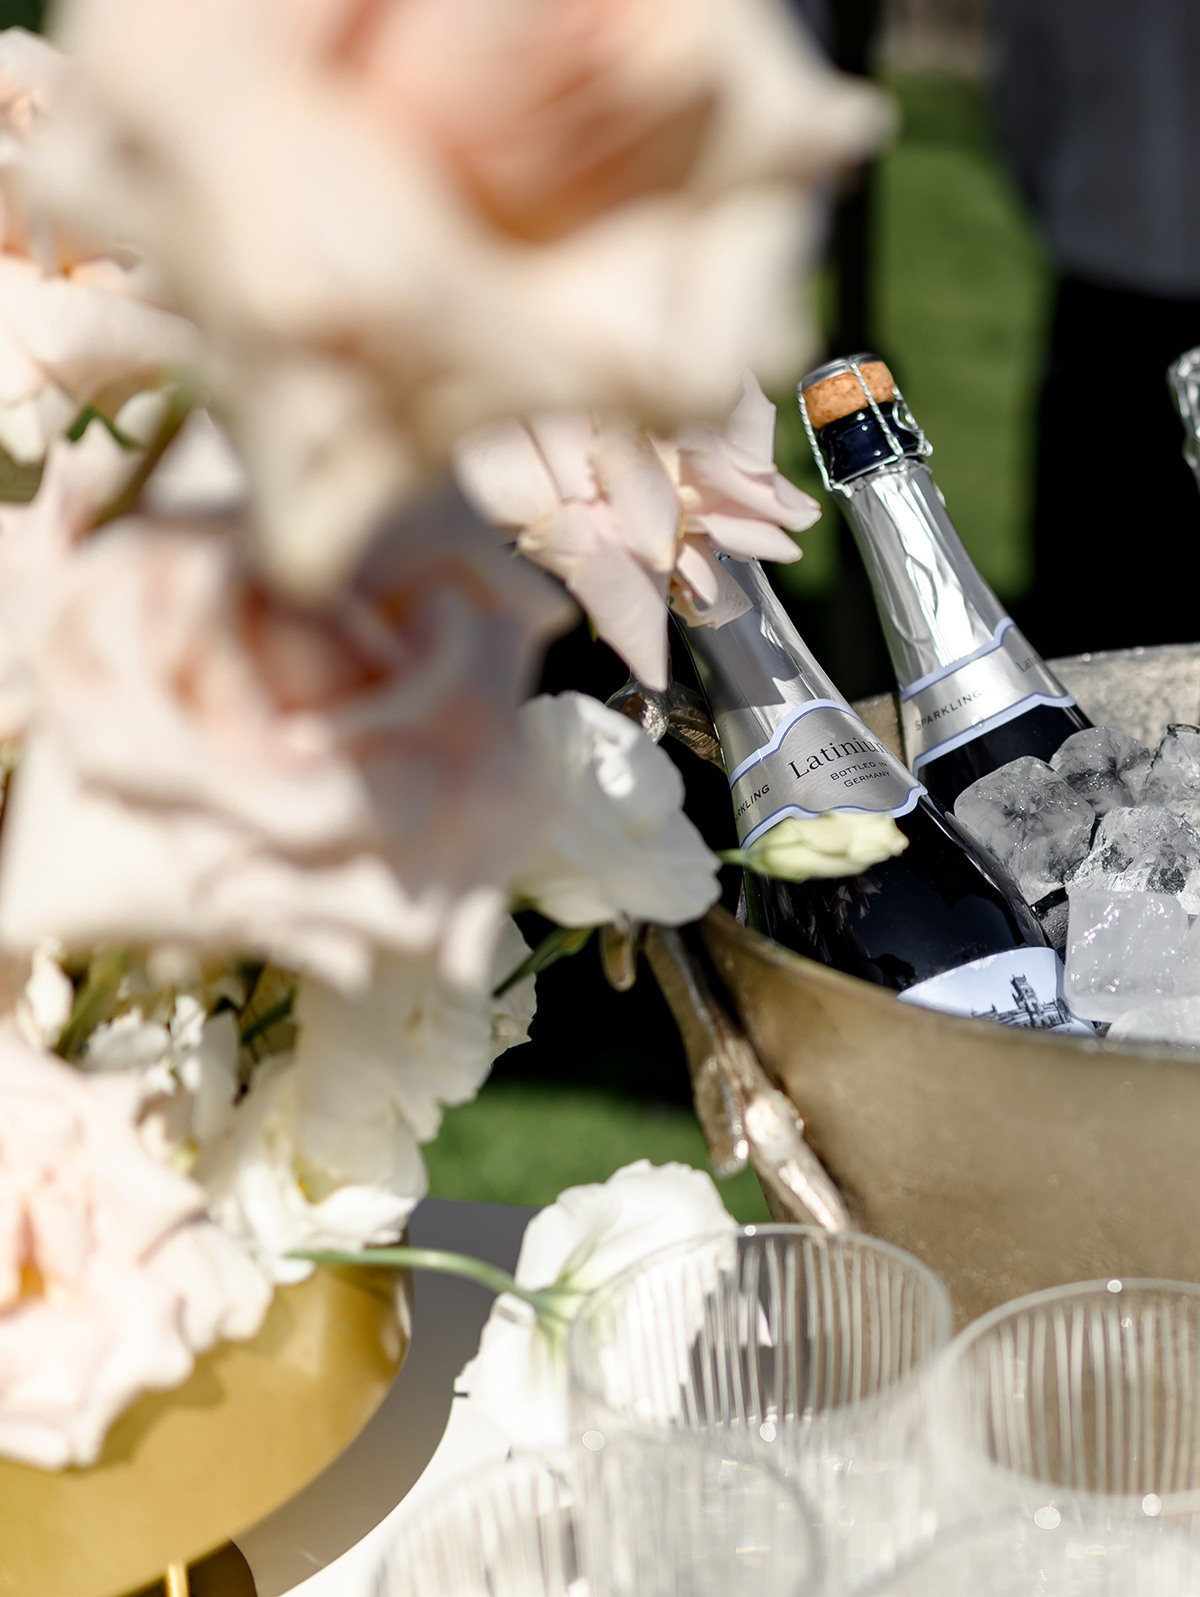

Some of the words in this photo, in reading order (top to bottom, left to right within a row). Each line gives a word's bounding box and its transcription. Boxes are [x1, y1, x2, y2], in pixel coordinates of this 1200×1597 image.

[915, 690, 982, 731] SPARKLING
[788, 737, 889, 780] Latinium
[830, 761, 876, 781] BOTTLED
[843, 770, 891, 788] GERMANY
